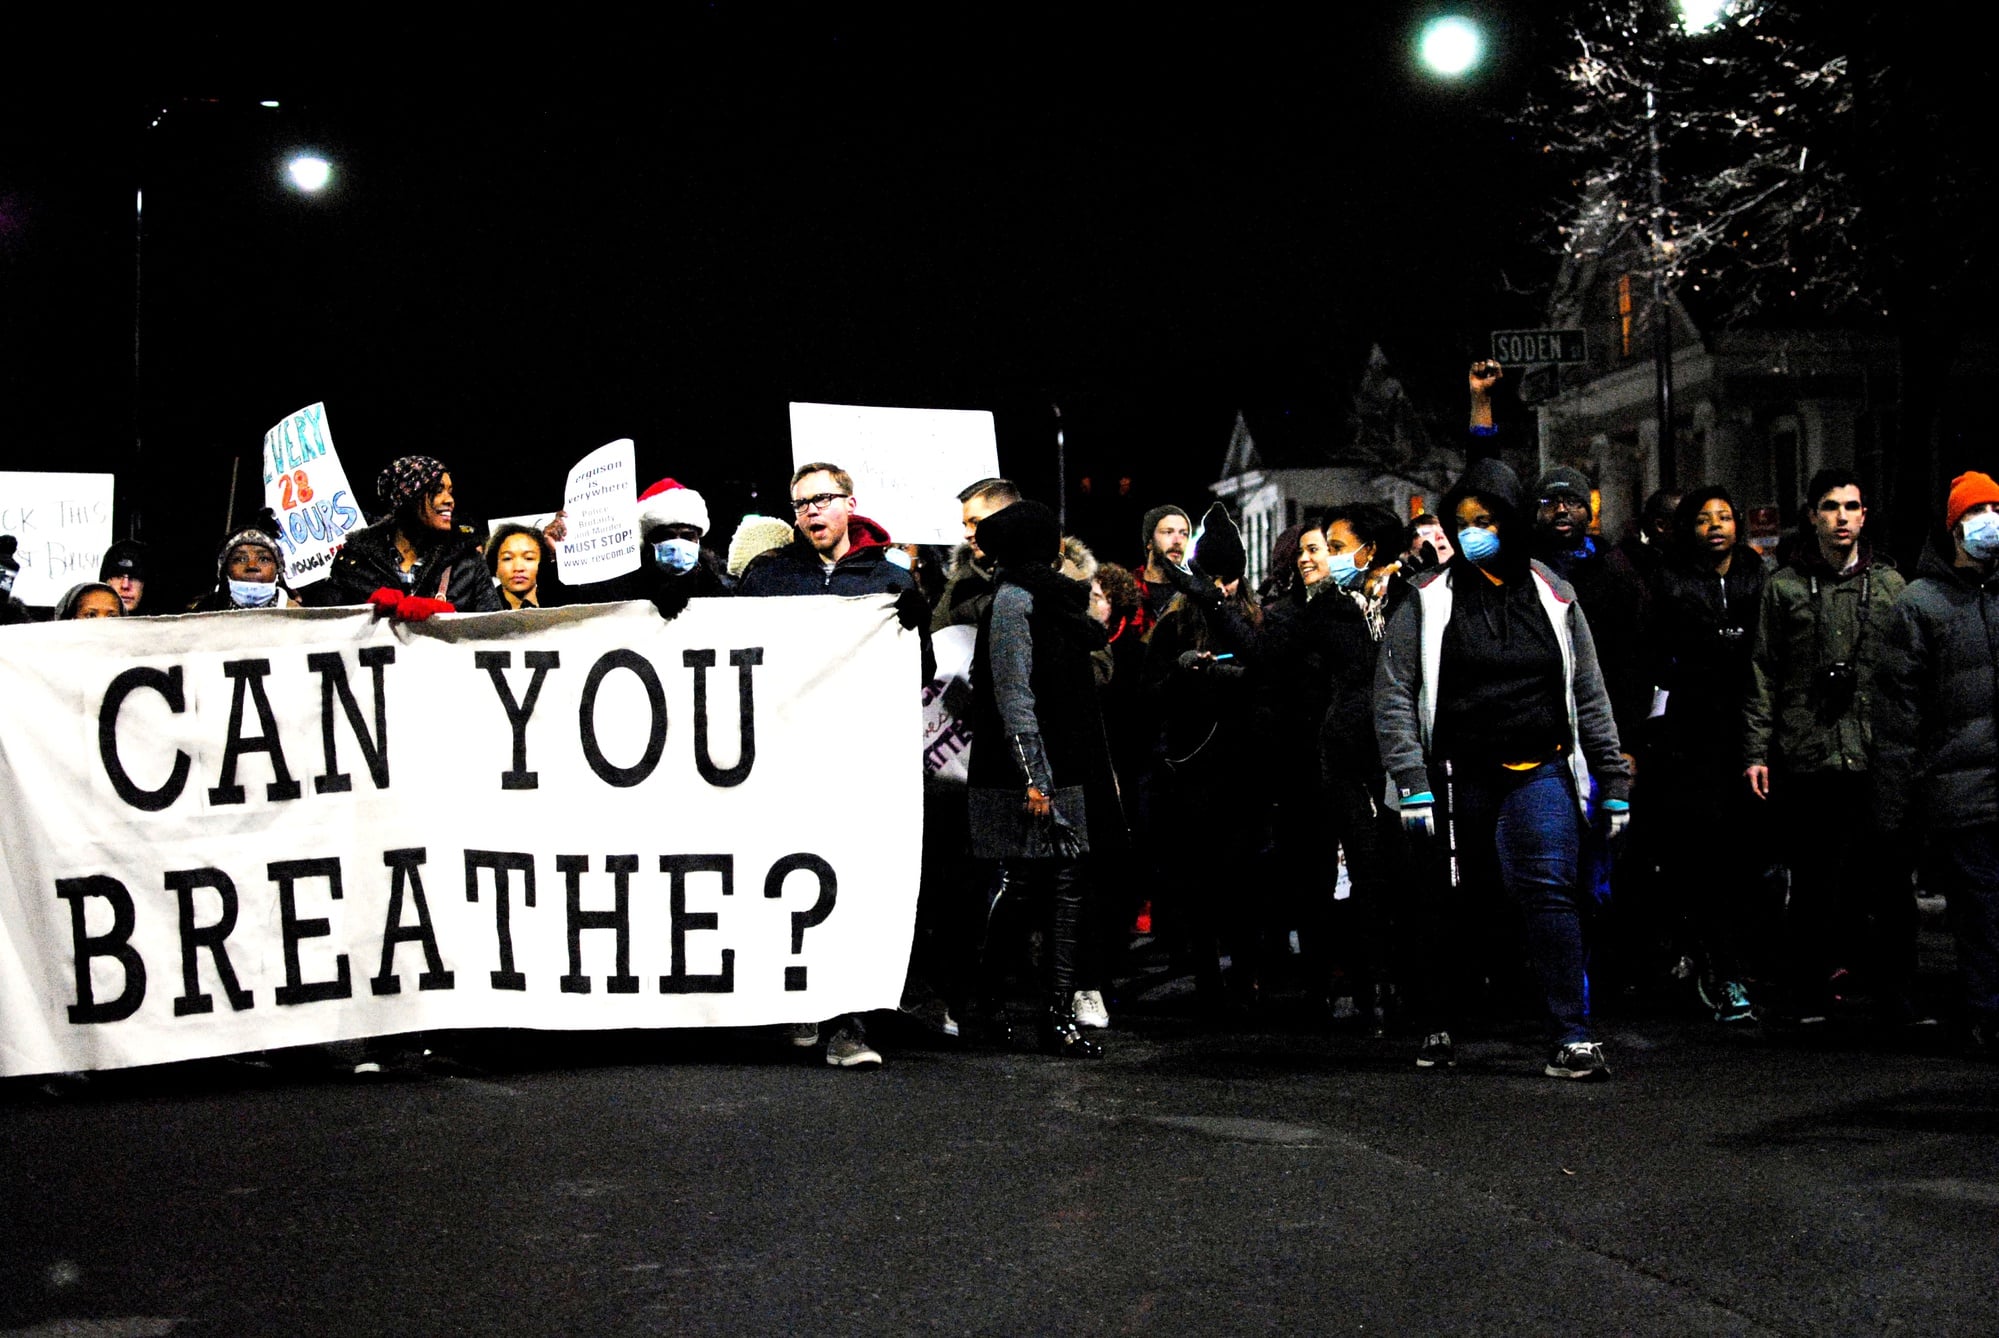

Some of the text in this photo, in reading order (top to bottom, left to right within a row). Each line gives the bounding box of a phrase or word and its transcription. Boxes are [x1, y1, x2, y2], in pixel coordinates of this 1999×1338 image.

[1498, 335, 1561, 361] SODEN
[575, 460, 622, 483] erguson
[278, 470, 313, 511] 28
[568, 481, 629, 504] verywhere
[51, 501, 107, 528] THIS
[275, 490, 358, 555] HOURS
[564, 529, 633, 554] MUST STOP!
[98, 645, 764, 812] CAN YOU
[55, 846, 838, 1026] BREATHE?
